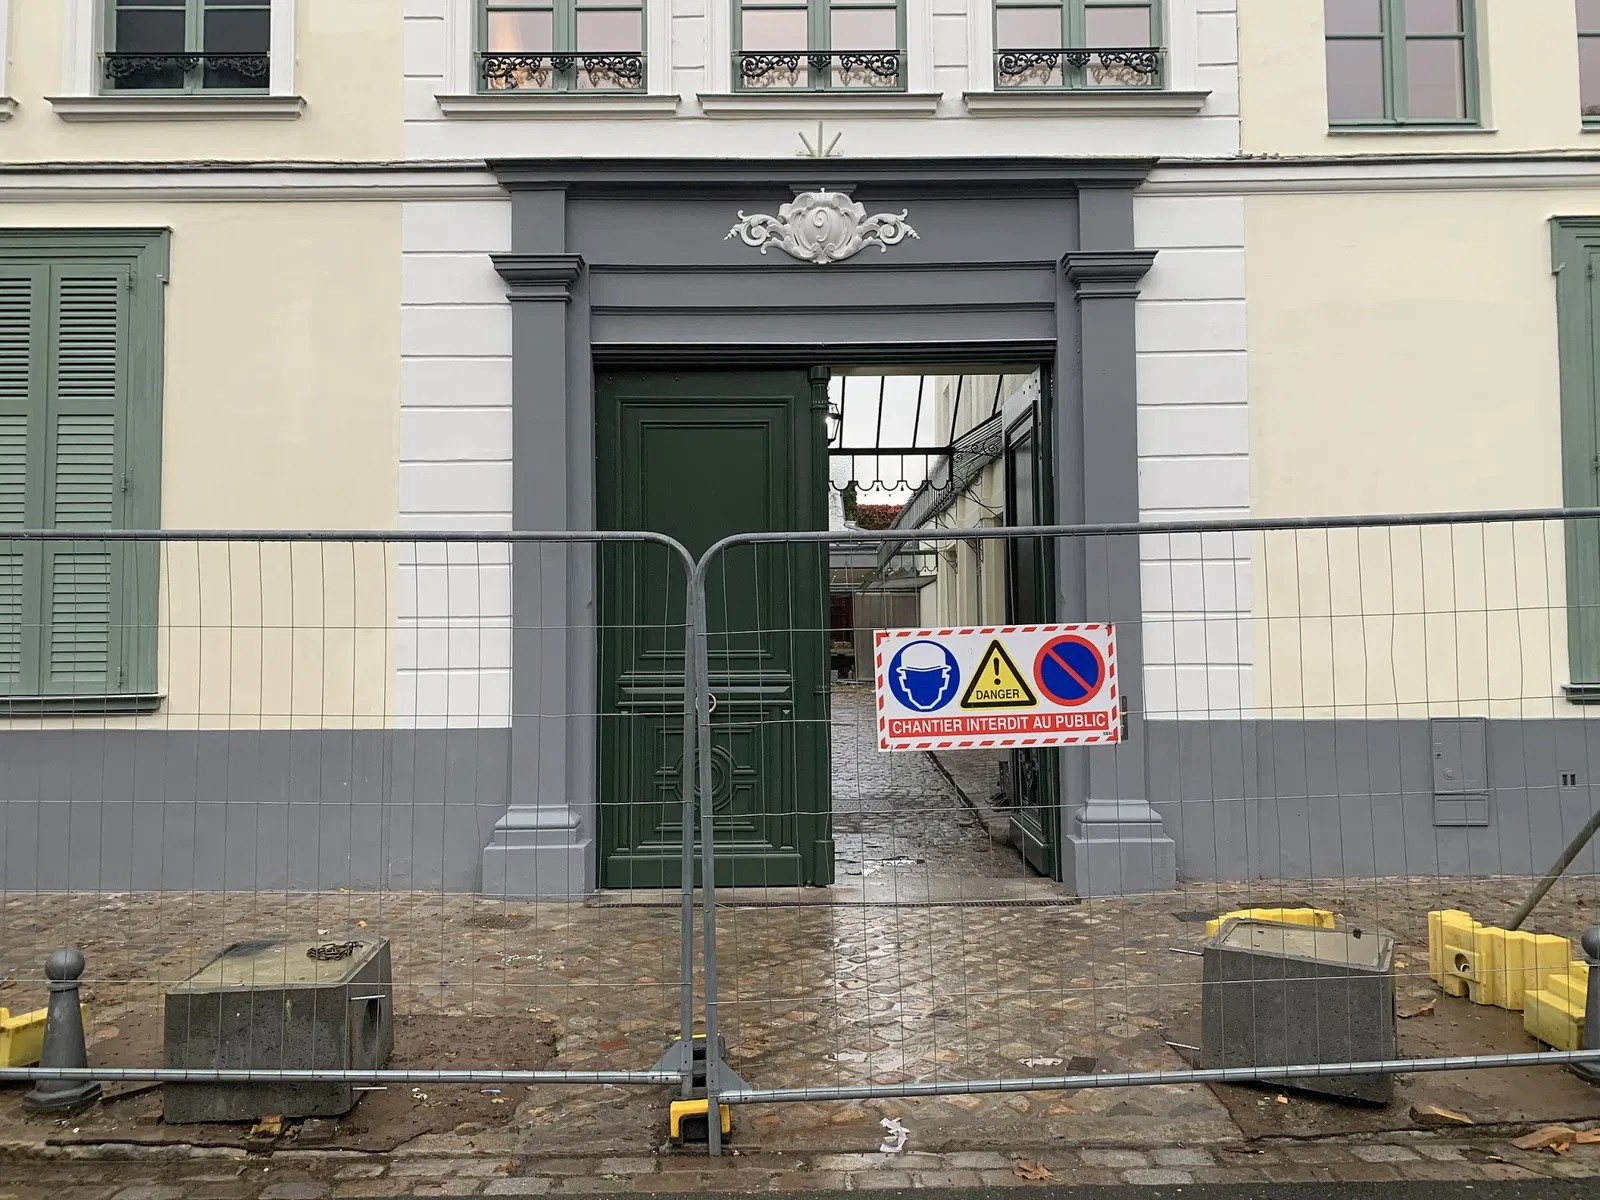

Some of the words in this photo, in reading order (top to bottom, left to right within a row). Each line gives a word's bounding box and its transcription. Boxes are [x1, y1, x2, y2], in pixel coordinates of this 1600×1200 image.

[976, 689, 1020, 700] DANGER
[892, 718, 963, 734] CHANTIER
[966, 716, 1029, 731] INTERDIT
[1033, 715, 1051, 729] AU
[1055, 713, 1106, 728] PUBLIC
